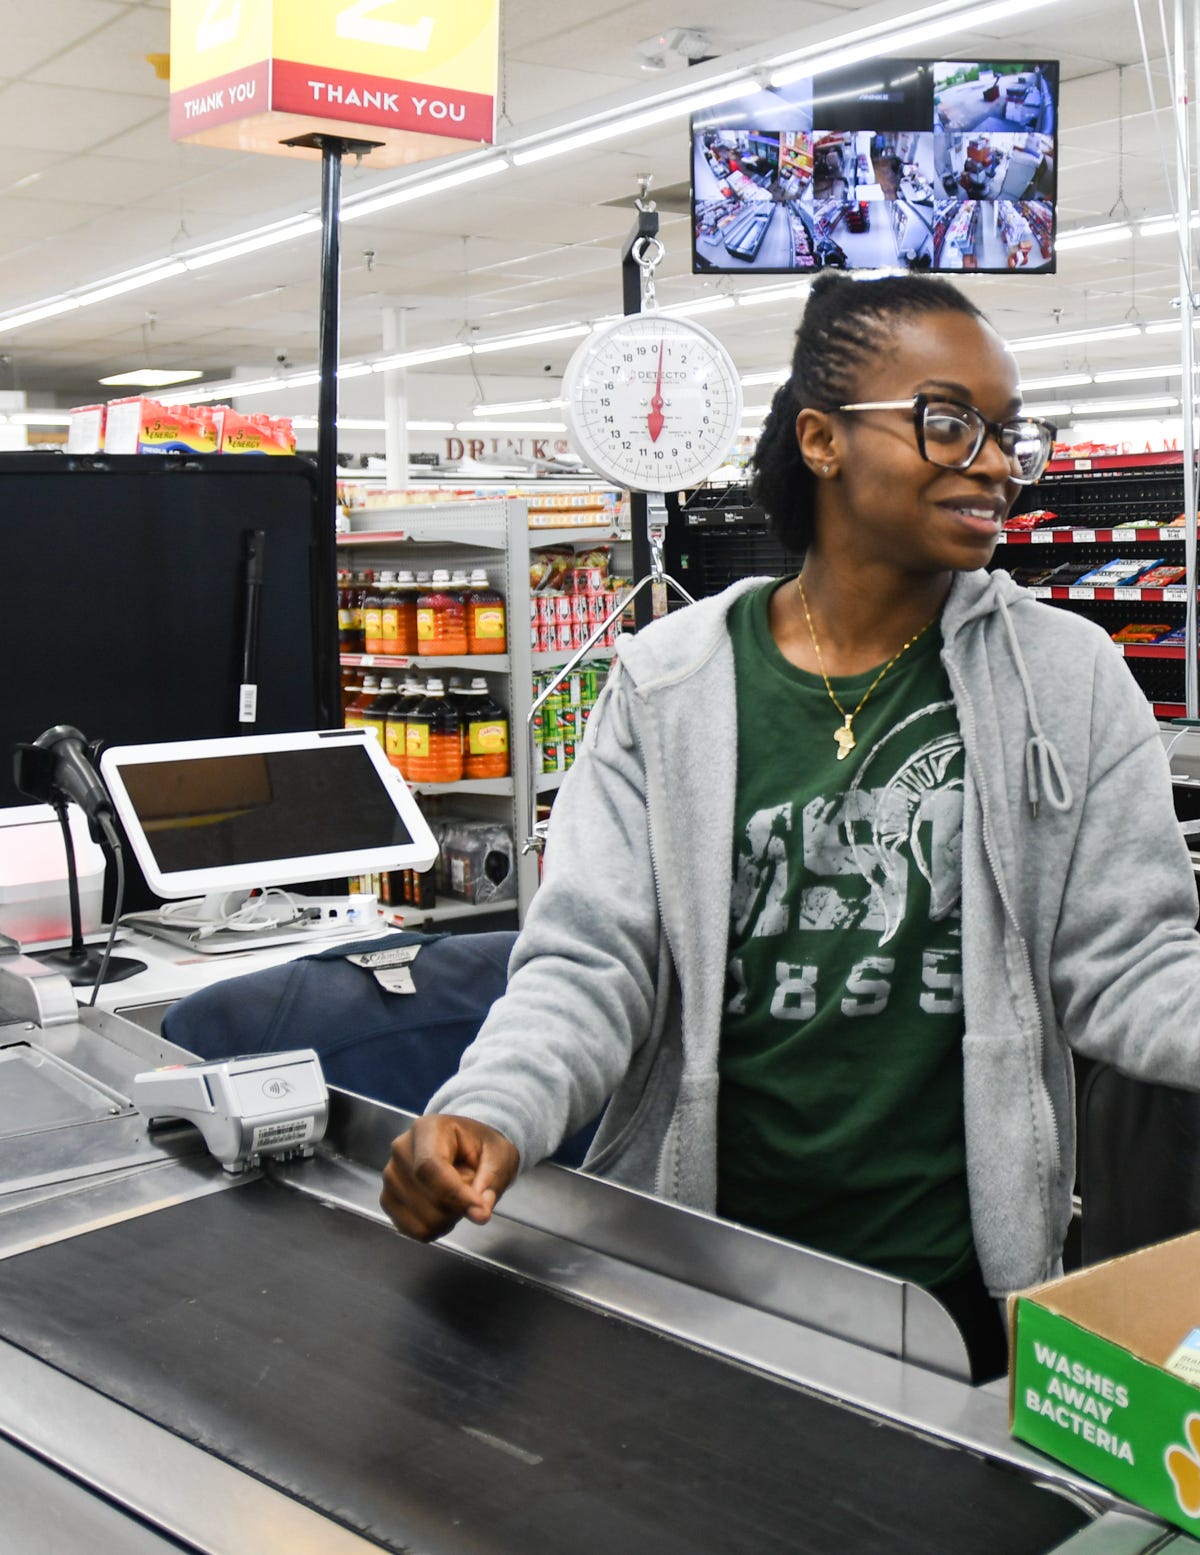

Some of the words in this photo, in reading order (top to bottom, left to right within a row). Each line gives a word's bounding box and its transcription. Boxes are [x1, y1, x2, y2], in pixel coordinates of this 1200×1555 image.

[184, 91, 224, 119] THANK
[228, 80, 256, 105] YOU
[307, 80, 399, 113] THANK
[410, 96, 466, 122] YOU
[638, 371, 687, 379] DETECTO
[149, 431, 178, 439] ENERGY
[232, 440, 260, 449] ENERGY
[1034, 1342, 1129, 1408] WASHES
[1047, 1377, 1113, 1424] AWAY
[1026, 1388, 1134, 1466] BACTERIA
